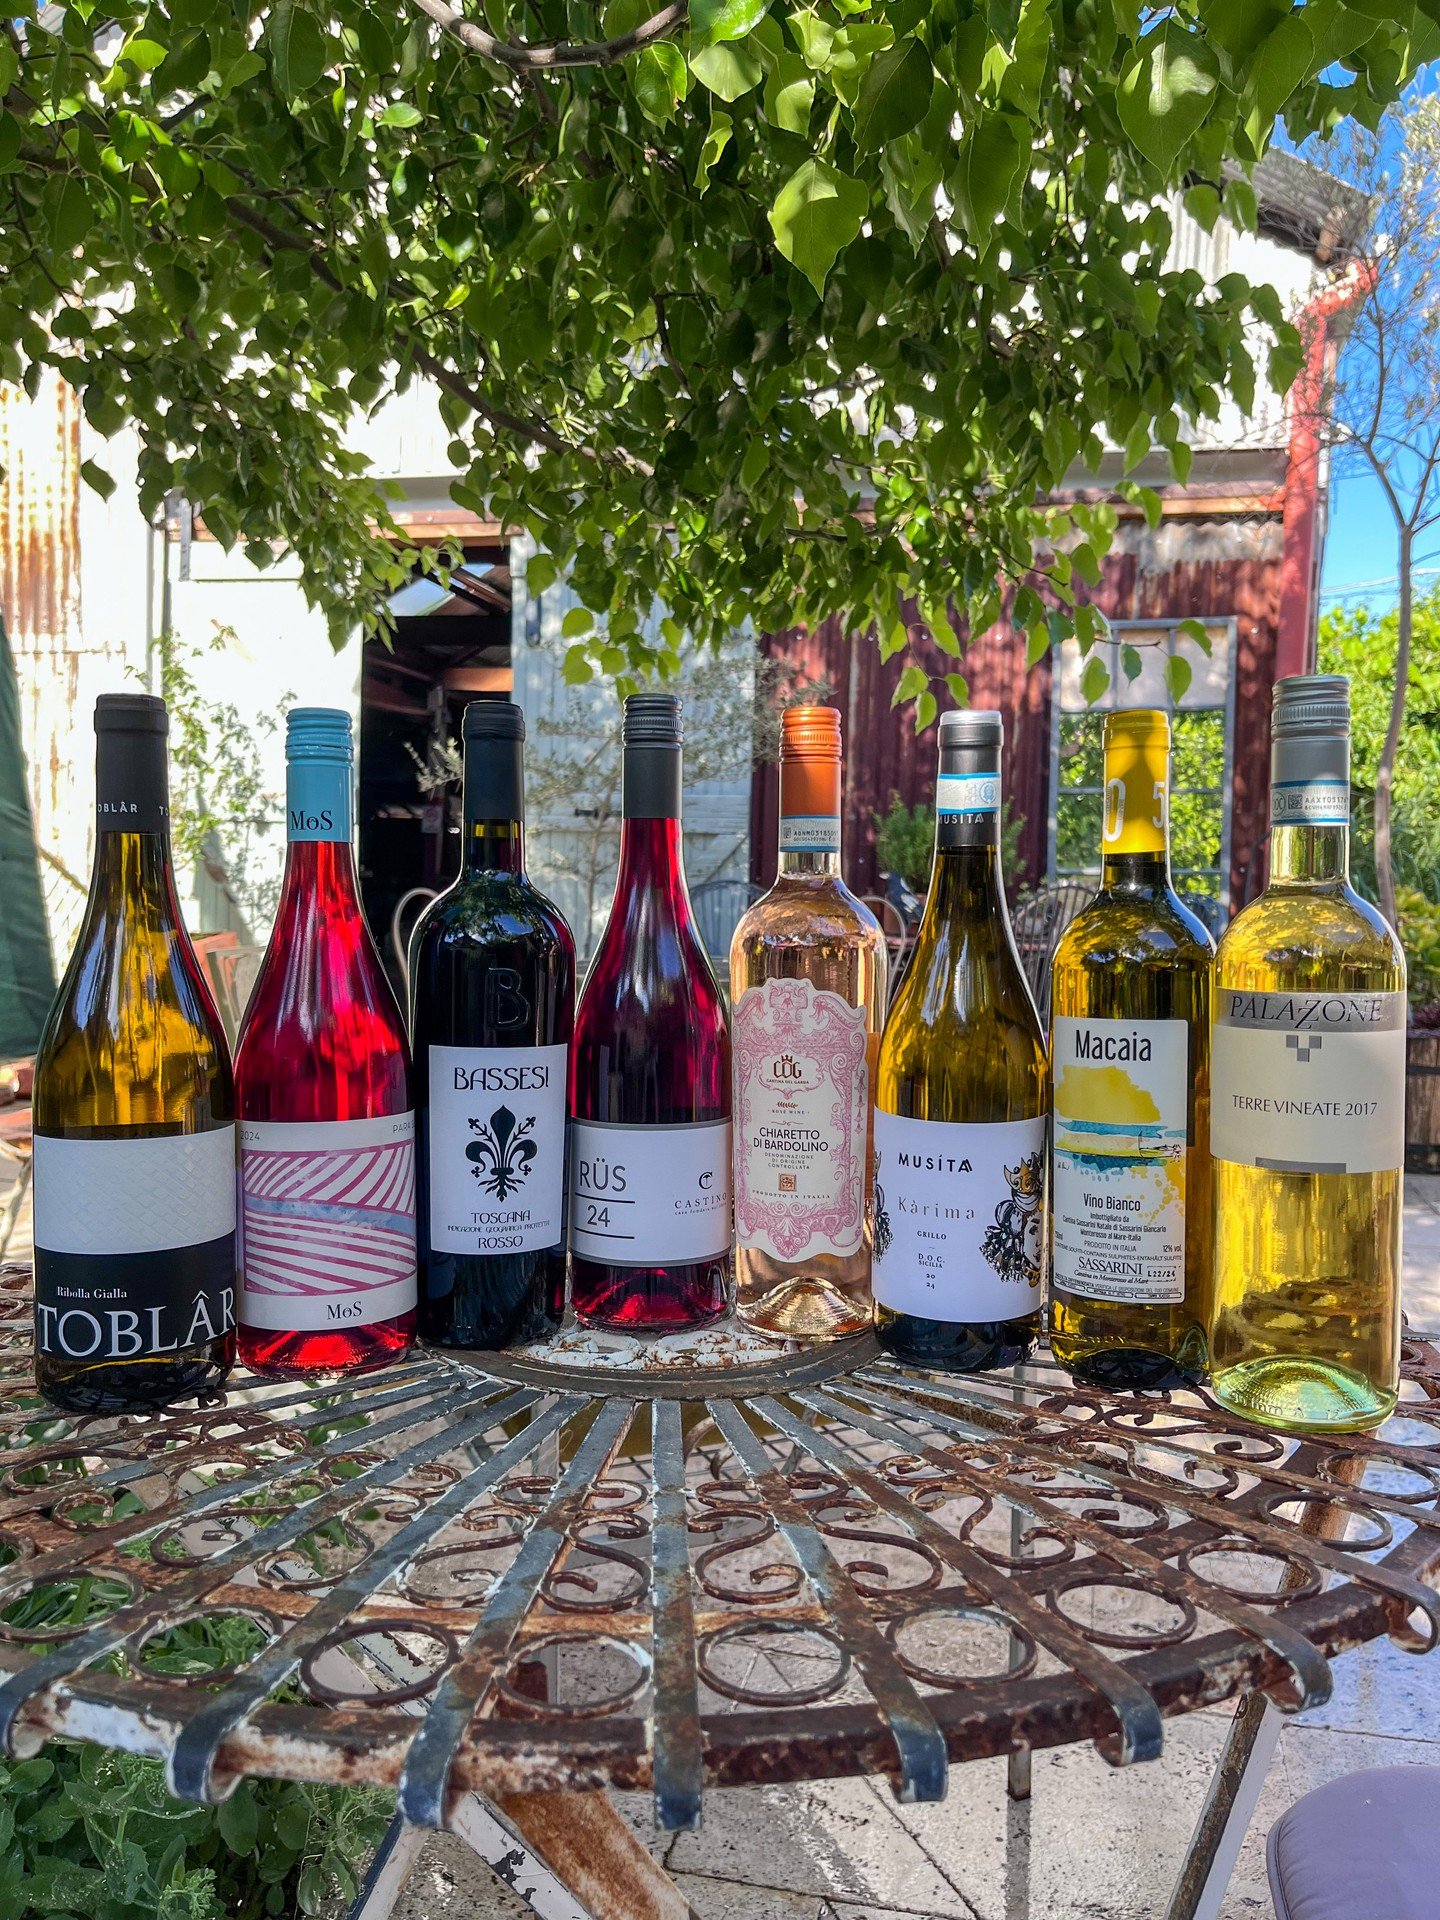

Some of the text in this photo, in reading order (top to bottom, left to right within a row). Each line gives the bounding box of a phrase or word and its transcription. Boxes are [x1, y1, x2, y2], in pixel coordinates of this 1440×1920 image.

[290, 810, 333, 831] MoS
[1075, 1029, 1151, 1061] Macaia
[454, 1066, 549, 1091] BASSESI
[1232, 1095, 1378, 1116] TERRE VINEATE 2017
[240, 1130, 260, 1141] 2024
[759, 1126, 820, 1140] CHIARETTO
[753, 1137, 829, 1152] DI BARDOLINO
[764, 1151, 814, 1160] DENOMINAZIONE
[767, 1162, 810, 1170] CONTROLLATA
[579, 1157, 627, 1193] RÜS
[752, 1189, 787, 1199] PRODOTTO
[898, 1196, 975, 1220] Kàrima
[1084, 1193, 1141, 1211] Vino Bianco
[471, 1209, 531, 1225] TOSCANA
[587, 1204, 611, 1228] 24
[478, 1235, 524, 1249] ROSSO
[916, 1230, 947, 1241] GRILLO
[1084, 1239, 1137, 1252] PRODOTTO IN ITALIA
[918, 1260, 943, 1269] SICILIA
[1078, 1257, 1143, 1275] SASSARINI
[1147, 1270, 1176, 1278] L22/24
[57, 1286, 128, 1299] Ribolla Gialla
[326, 1300, 362, 1320] MoS
[37, 1287, 236, 1358] TOBLÂR
